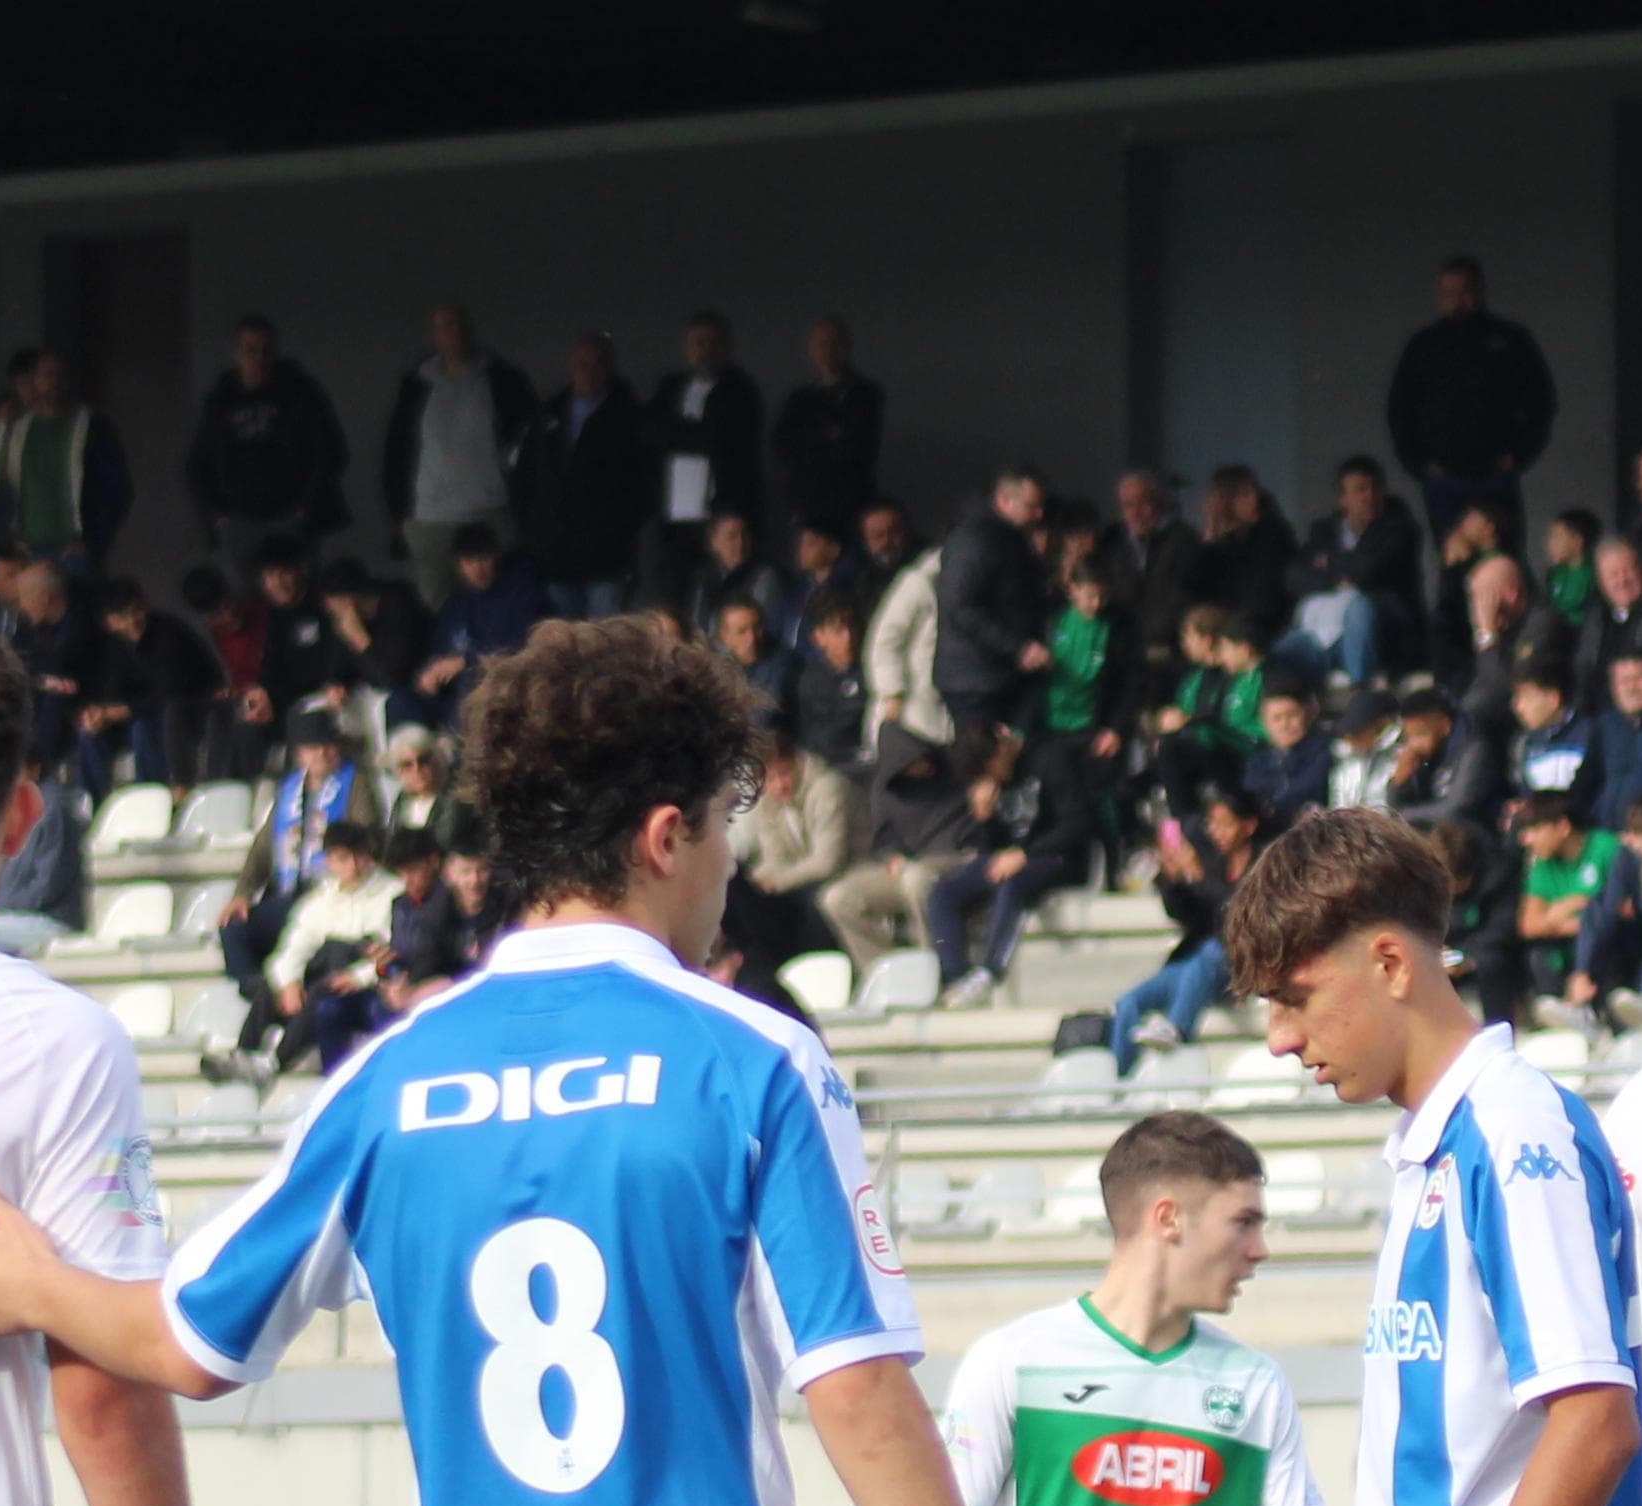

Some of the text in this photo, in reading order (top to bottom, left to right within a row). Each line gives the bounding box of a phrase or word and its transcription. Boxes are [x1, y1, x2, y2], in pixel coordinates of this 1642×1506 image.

[399, 1054, 662, 1133] DIGI
[470, 1216, 625, 1494] 8
[1093, 1442, 1211, 1495] ABRIL
